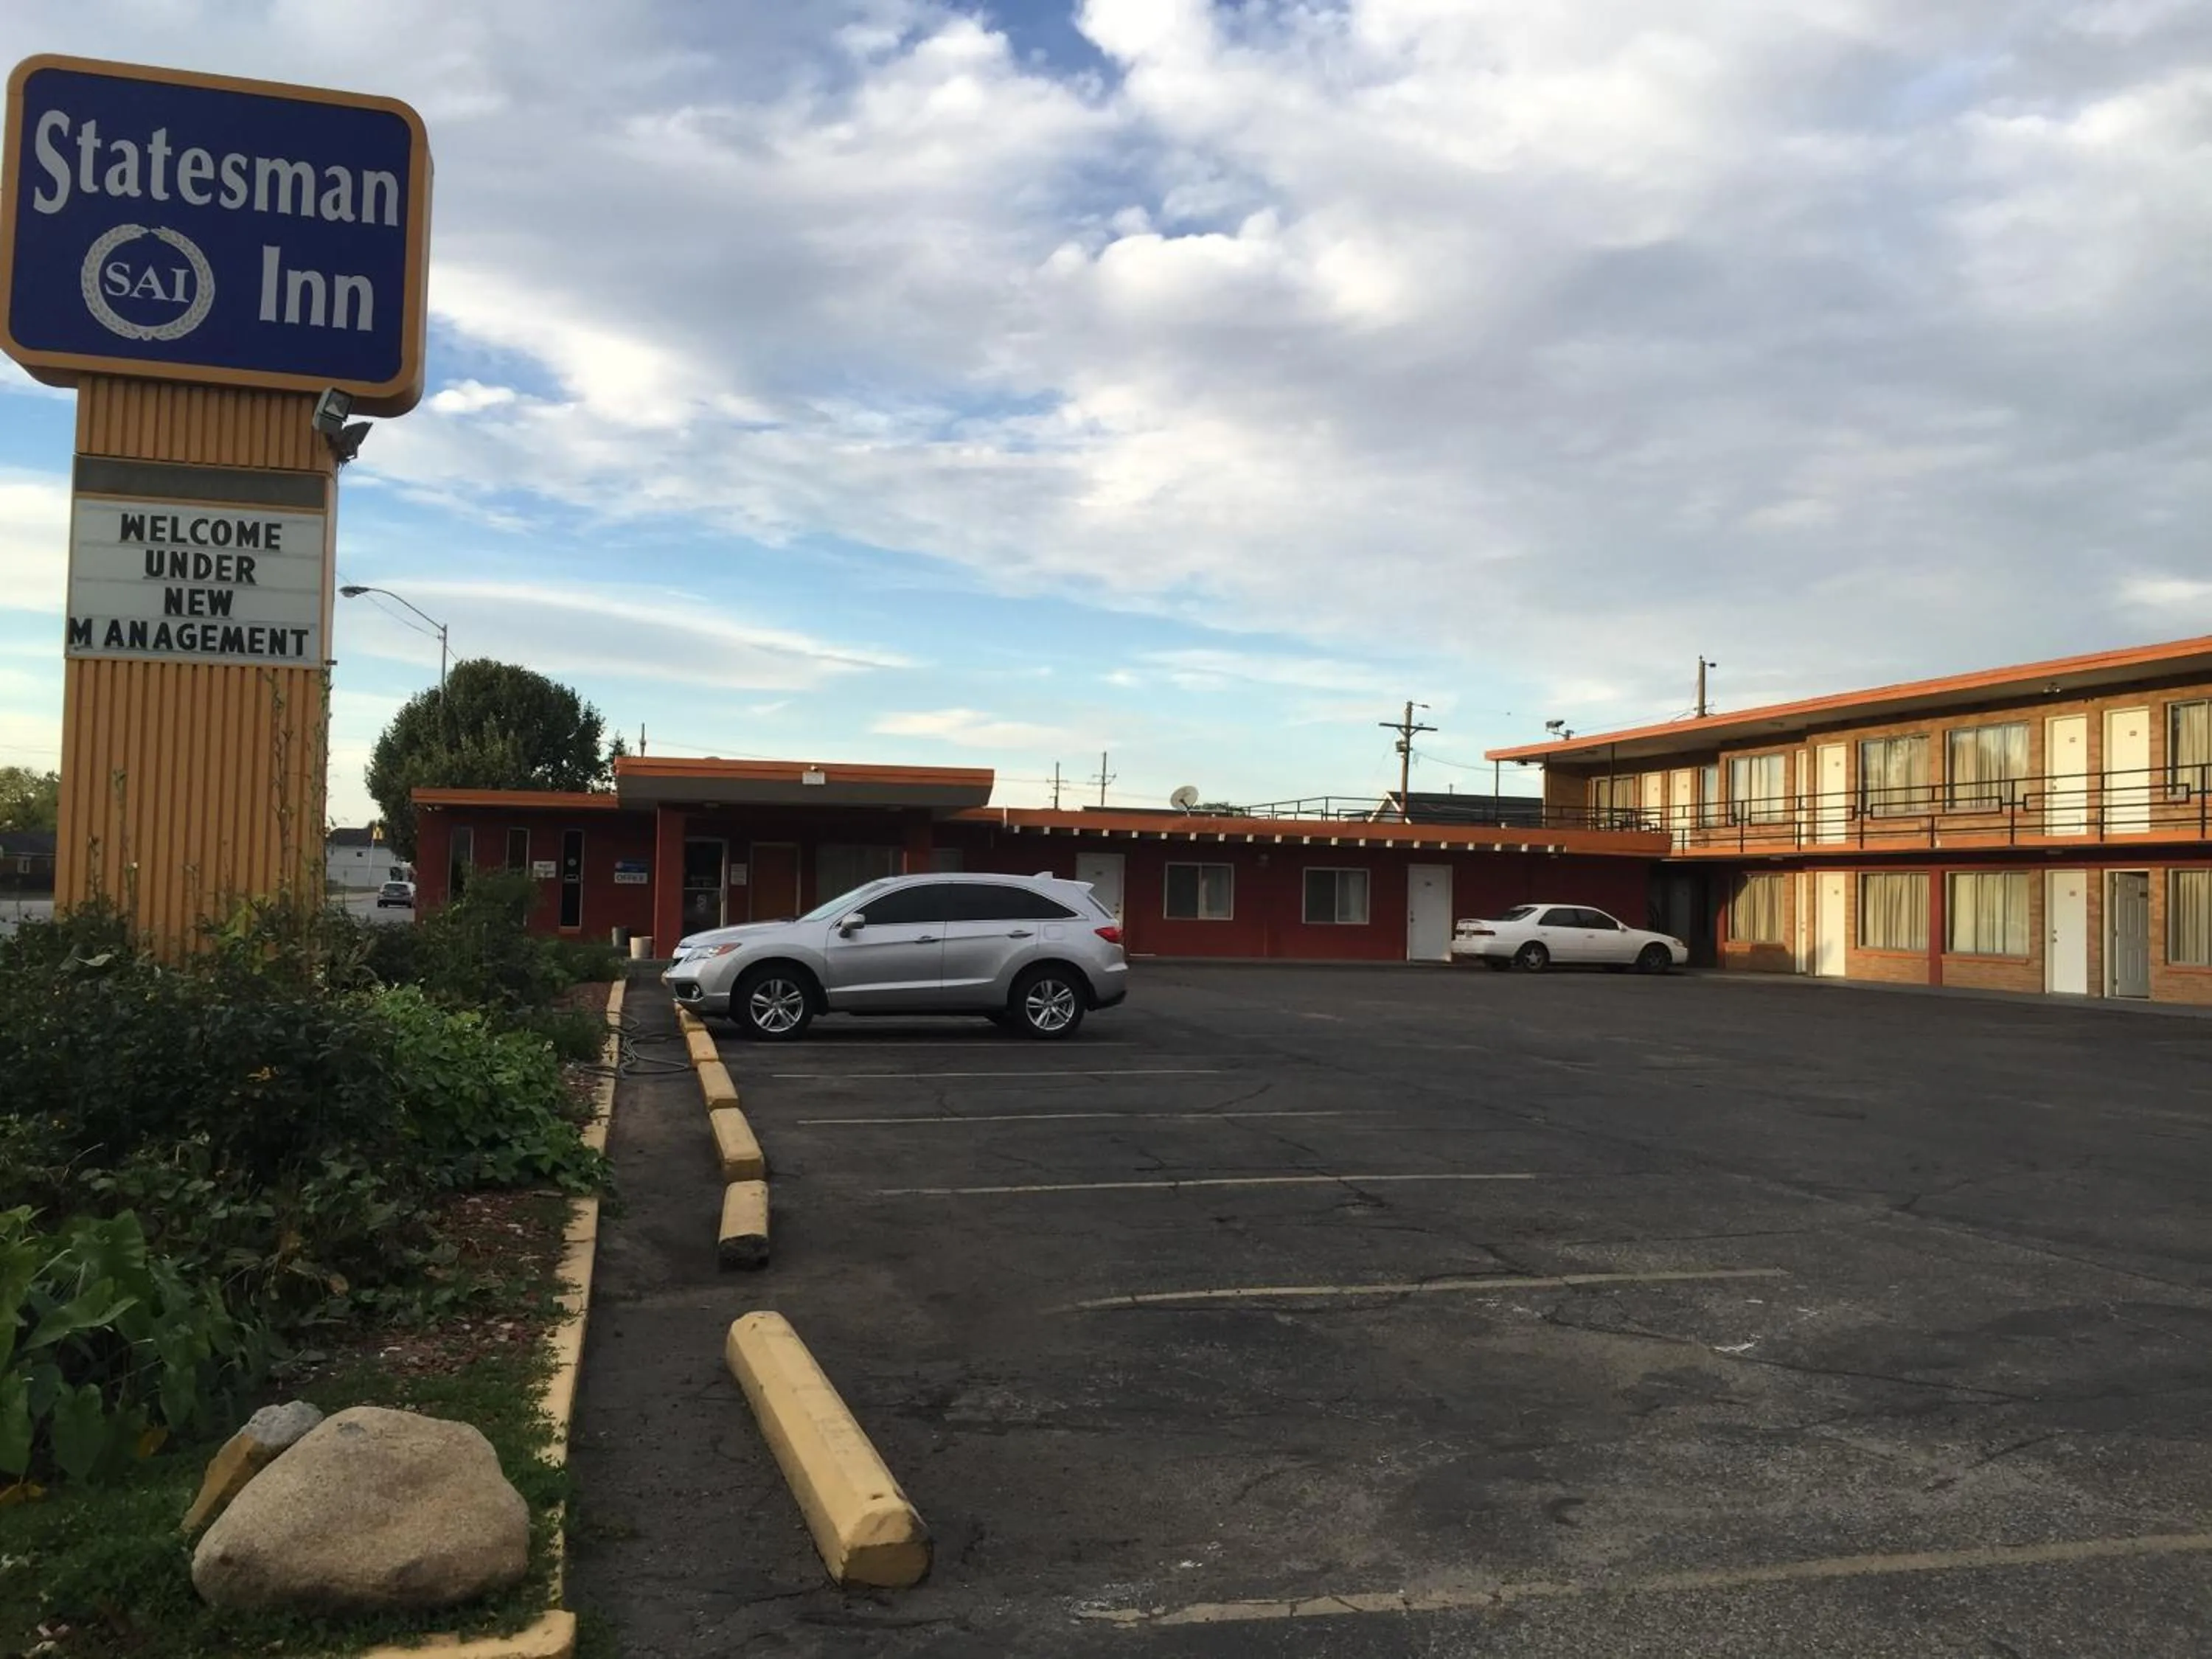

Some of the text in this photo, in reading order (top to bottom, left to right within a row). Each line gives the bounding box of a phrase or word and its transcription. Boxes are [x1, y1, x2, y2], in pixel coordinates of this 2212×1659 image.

[32, 109, 400, 227] Statesman
[104, 262, 190, 304] SAI
[259, 244, 375, 332] Inn
[119, 512, 282, 551] WELCOME
[144, 549, 257, 584] UNDER
[164, 586, 234, 617] NEW
[69, 617, 309, 656] MANAGEMENT
